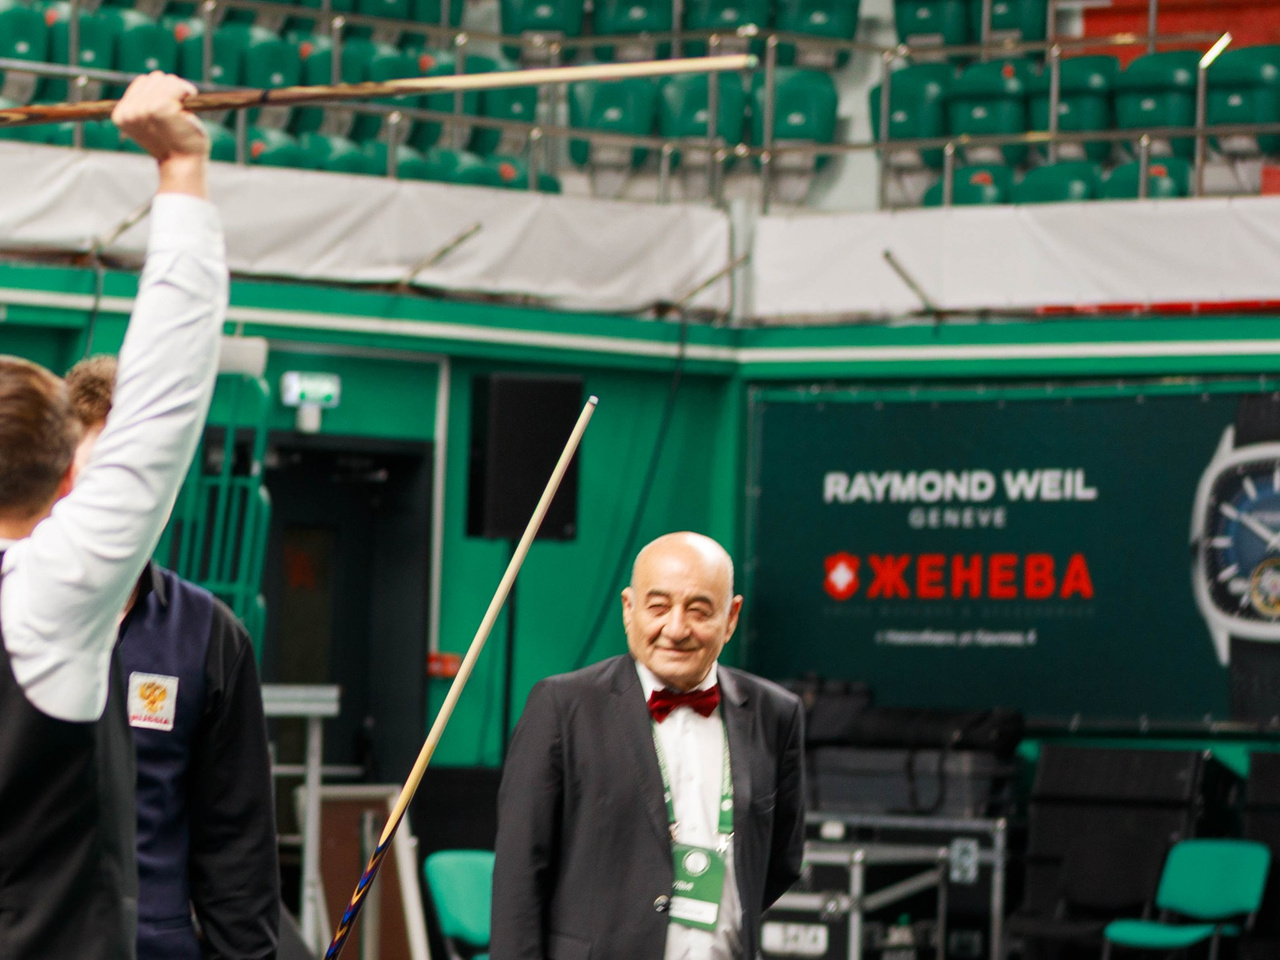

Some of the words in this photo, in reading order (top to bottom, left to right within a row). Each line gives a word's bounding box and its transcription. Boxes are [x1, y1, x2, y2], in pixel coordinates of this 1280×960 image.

[824, 471, 996, 503] RAYMOND
[1004, 468, 1098, 501] WEIL
[867, 553, 1095, 599] ЖЕНЕВА
